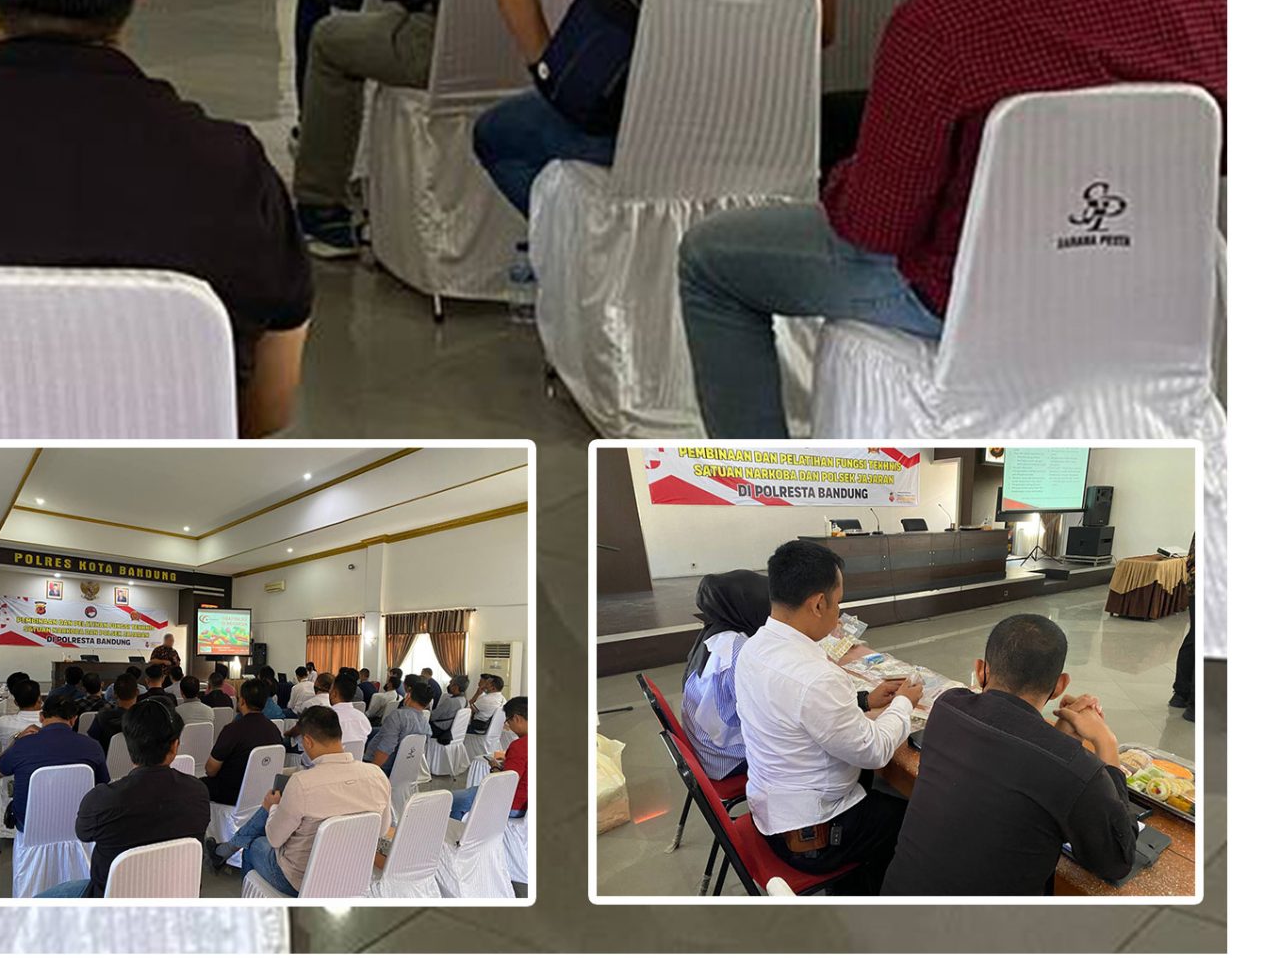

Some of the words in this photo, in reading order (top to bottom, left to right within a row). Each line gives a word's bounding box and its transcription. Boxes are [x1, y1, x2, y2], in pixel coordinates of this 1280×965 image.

[679, 447, 753, 463] PEMBINAAN
[754, 450, 778, 464] DAN
[780, 453, 833, 467] PELATIHAN
[835, 457, 867, 470] FUNGSI
[693, 464, 743, 478] SATUAN
[744, 467, 799, 481] NARKOBA
[800, 470, 819, 482] DAN
[820, 471, 856, 483] POLSEK
[857, 473, 895, 485] JAJARAN
[737, 484, 751, 497] DI
[755, 484, 816, 499] POLRESTA
[818, 487, 869, 500] BANDUNG
[14, 552, 72, 569] POLRES
[79, 560, 113, 574] KOTA
[119, 566, 177, 582] BANDUNG
[58, 636, 95, 645] POLRESTA
[97, 638, 131, 646] BANDUNG
